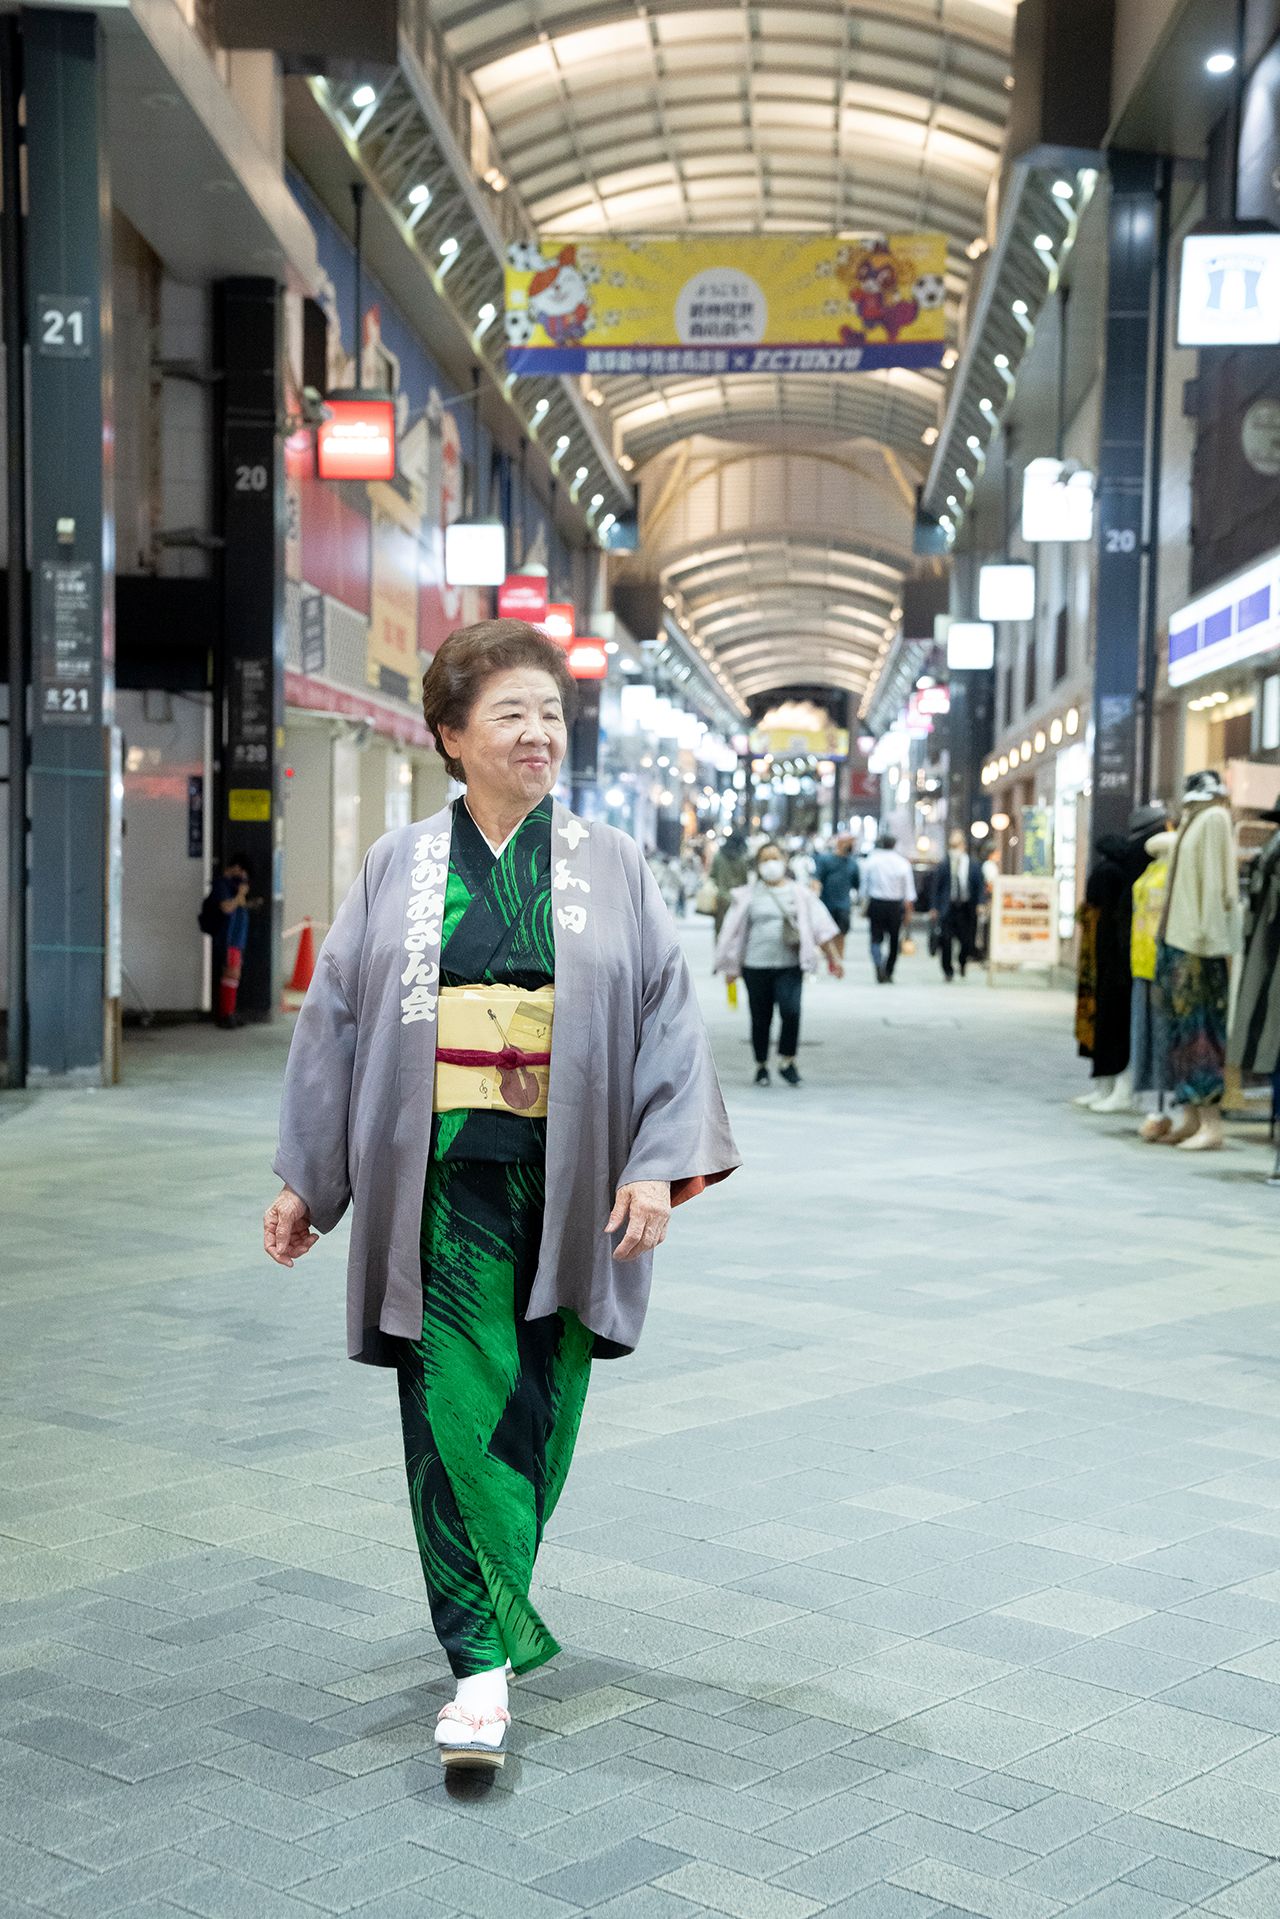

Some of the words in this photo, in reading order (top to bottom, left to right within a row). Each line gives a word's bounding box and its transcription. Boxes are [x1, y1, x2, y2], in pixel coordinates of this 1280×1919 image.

[42, 309, 83, 346] 21
[235, 465, 267, 491] 20
[1105, 529, 1136, 553] 20
[62, 688, 89, 712] 21
[401, 831, 451, 1025] おかみさん会
